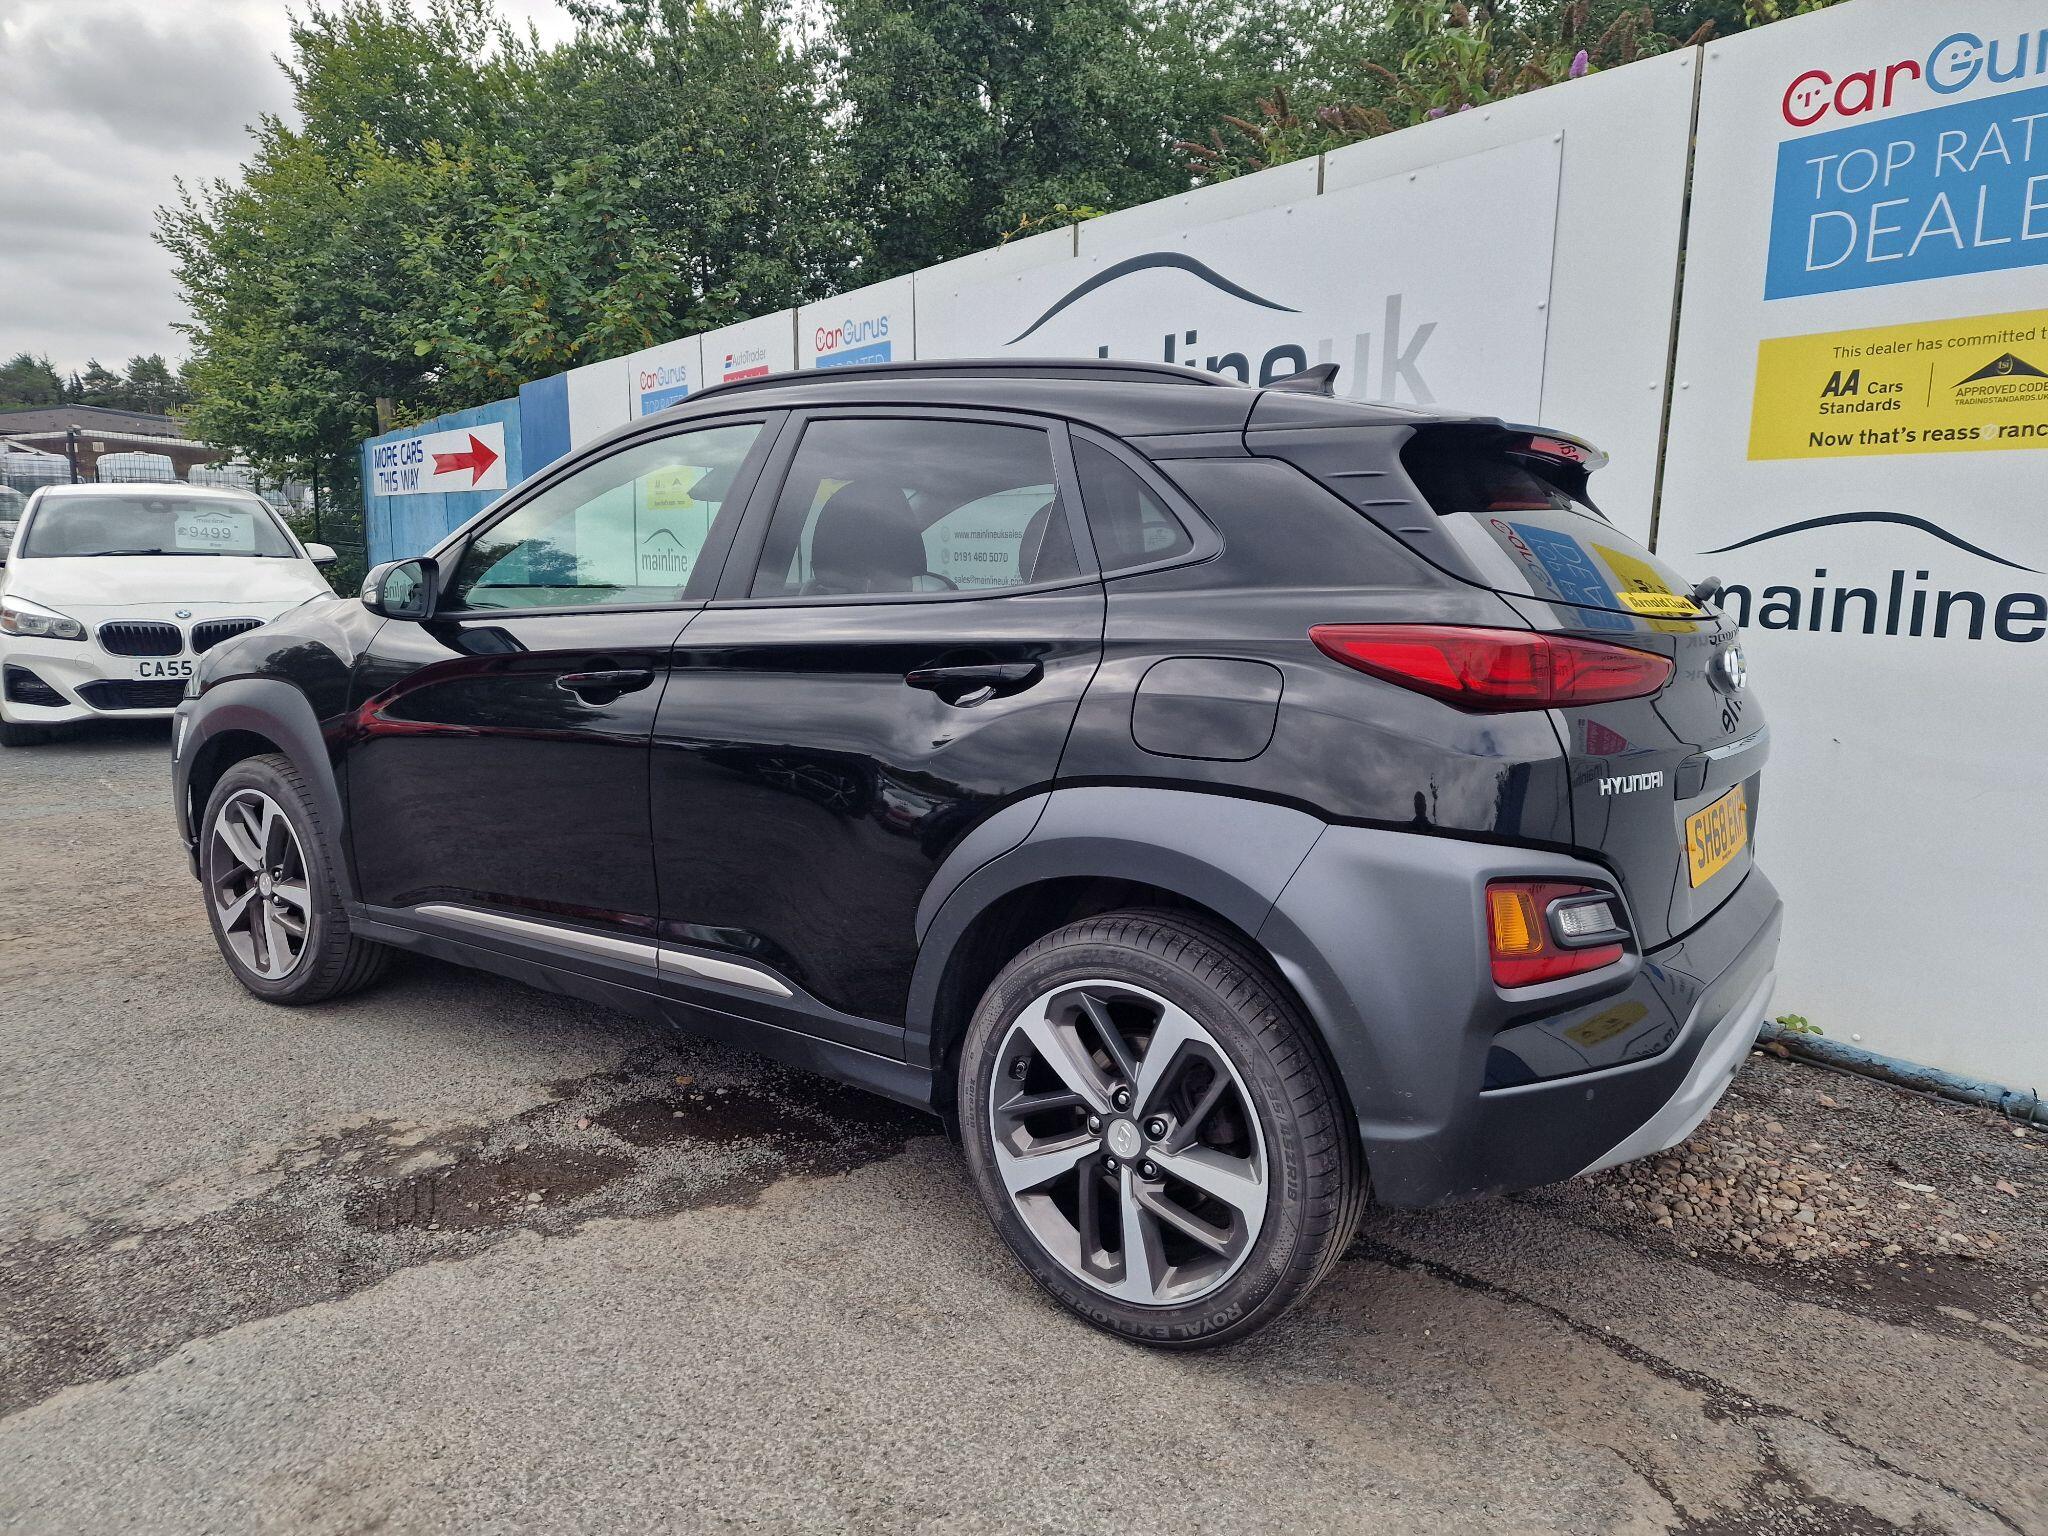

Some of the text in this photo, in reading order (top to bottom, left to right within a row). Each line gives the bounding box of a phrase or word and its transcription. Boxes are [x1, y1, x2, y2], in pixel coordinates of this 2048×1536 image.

[1806, 140, 1917, 200] TOP
[815, 316, 889, 352] CarGurus
[1833, 345, 1862, 359] This
[1865, 340, 1912, 356] dealer
[1916, 338, 1943, 351] has
[1947, 327, 2036, 348] committed
[640, 365, 687, 391] CarGurus
[1820, 369, 1904, 398] AA Cars
[1955, 380, 2048, 398] APPROVED CODE
[1818, 397, 1902, 415] Standards
[1954, 393, 2048, 406] TRADINGSTANDARDS.UK
[1808, 423, 2048, 448] Now that's reassranc
[374, 440, 424, 469] MORE CARS
[379, 467, 420, 492] THIS WAY
[177, 526, 231, 539] £9499
[641, 547, 688, 572] mainline
[953, 551, 1009, 563] 0191 460 5070
[139, 660, 193, 678] CA55
[1599, 770, 1664, 796] HYUNDAI
[1695, 804, 1728, 869] SH68
[1173, 1302, 1244, 1338] ROYAL
